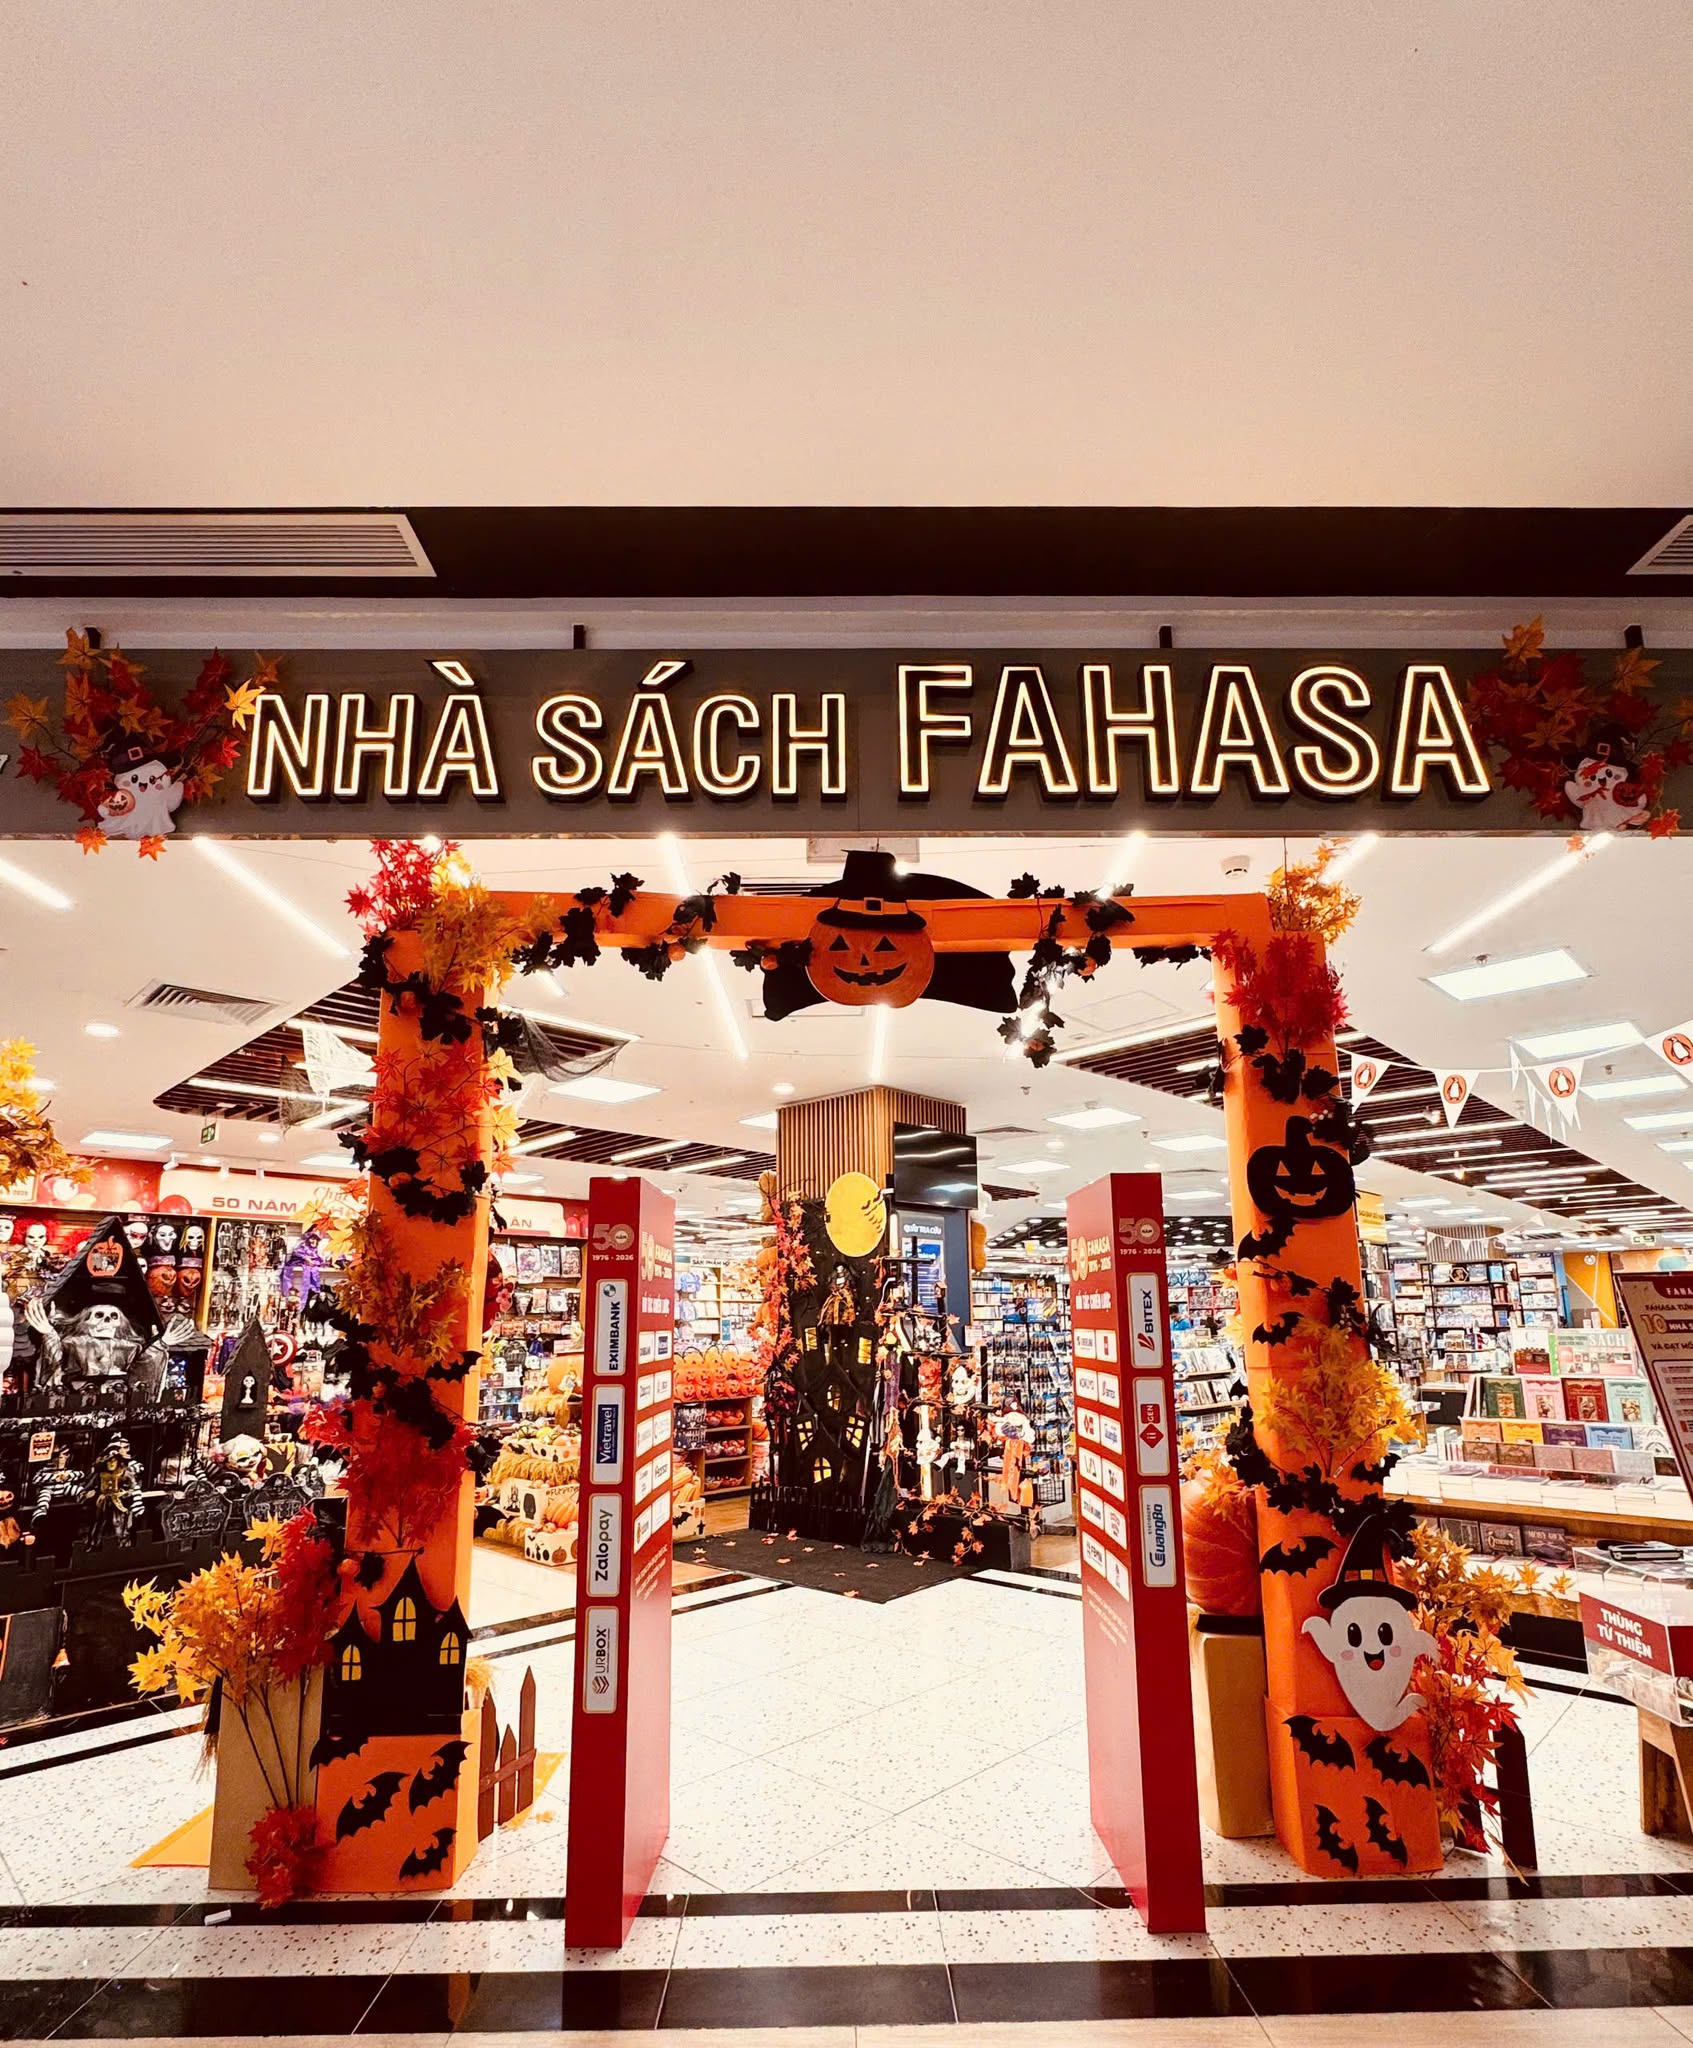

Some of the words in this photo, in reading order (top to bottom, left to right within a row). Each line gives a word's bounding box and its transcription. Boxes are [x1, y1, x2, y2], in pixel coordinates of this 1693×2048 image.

[245, 660, 499, 798] NHÀ
[531, 660, 847, 798] SÁCH
[896, 664, 1490, 797] FAHASA
[212, 1197, 240, 1209] 50
[592, 1223, 635, 1251] 50
[1119, 1218, 1160, 1245] 50
[1143, 1290, 1154, 1333] BITEX
[1640, 1314, 1668, 1334] 10
[609, 1301, 620, 1370] EXIMBANK
[1146, 1405, 1154, 1421] GEN
[600, 1407, 612, 1462] Vietravel
[595, 1510, 613, 1581] Zalopay
[1600, 1607, 1643, 1637] THÙNG
[596, 1628, 606, 1673] URBOX
[1596, 1623, 1613, 1641] TỪ
[1614, 1631, 1652, 1659] THIỆN
